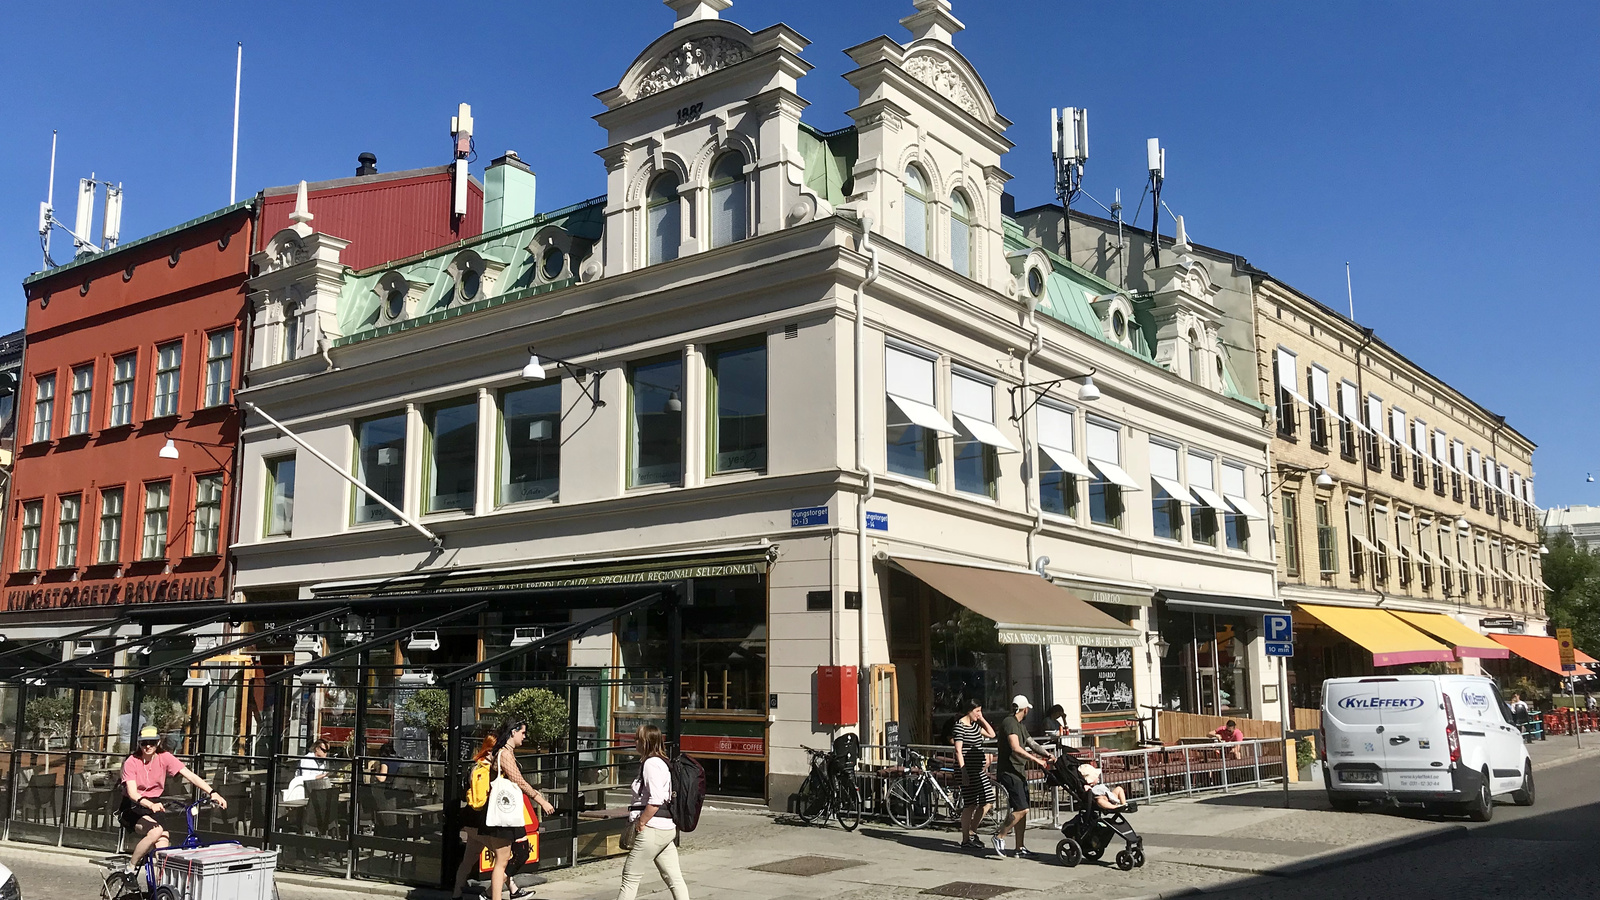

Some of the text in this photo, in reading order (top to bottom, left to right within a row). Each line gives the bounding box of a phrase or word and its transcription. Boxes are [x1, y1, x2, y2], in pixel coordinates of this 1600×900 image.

[675, 101, 704, 127] 1887
[792, 508, 828, 518] Kungstorget
[647, 569, 693, 581] REGIONALI
[7, 575, 217, 611] KUNGSTORGETS BRYGGHUS
[1091, 592, 1121, 604] ALDARDO
[1270, 617, 1287, 639] P
[998, 632, 1020, 643] PASTA
[1020, 633, 1043, 645] FRESCA
[1046, 634, 1064, 645] PIZZA
[1070, 635, 1092, 646] TAGLIO
[1095, 636, 1113, 647] BUFFÉ
[1277, 645, 1290, 653] min
[1097, 671, 1116, 679] ALDARDO
[720, 742, 732, 750] DELI
[742, 743, 763, 751] COFFEE
